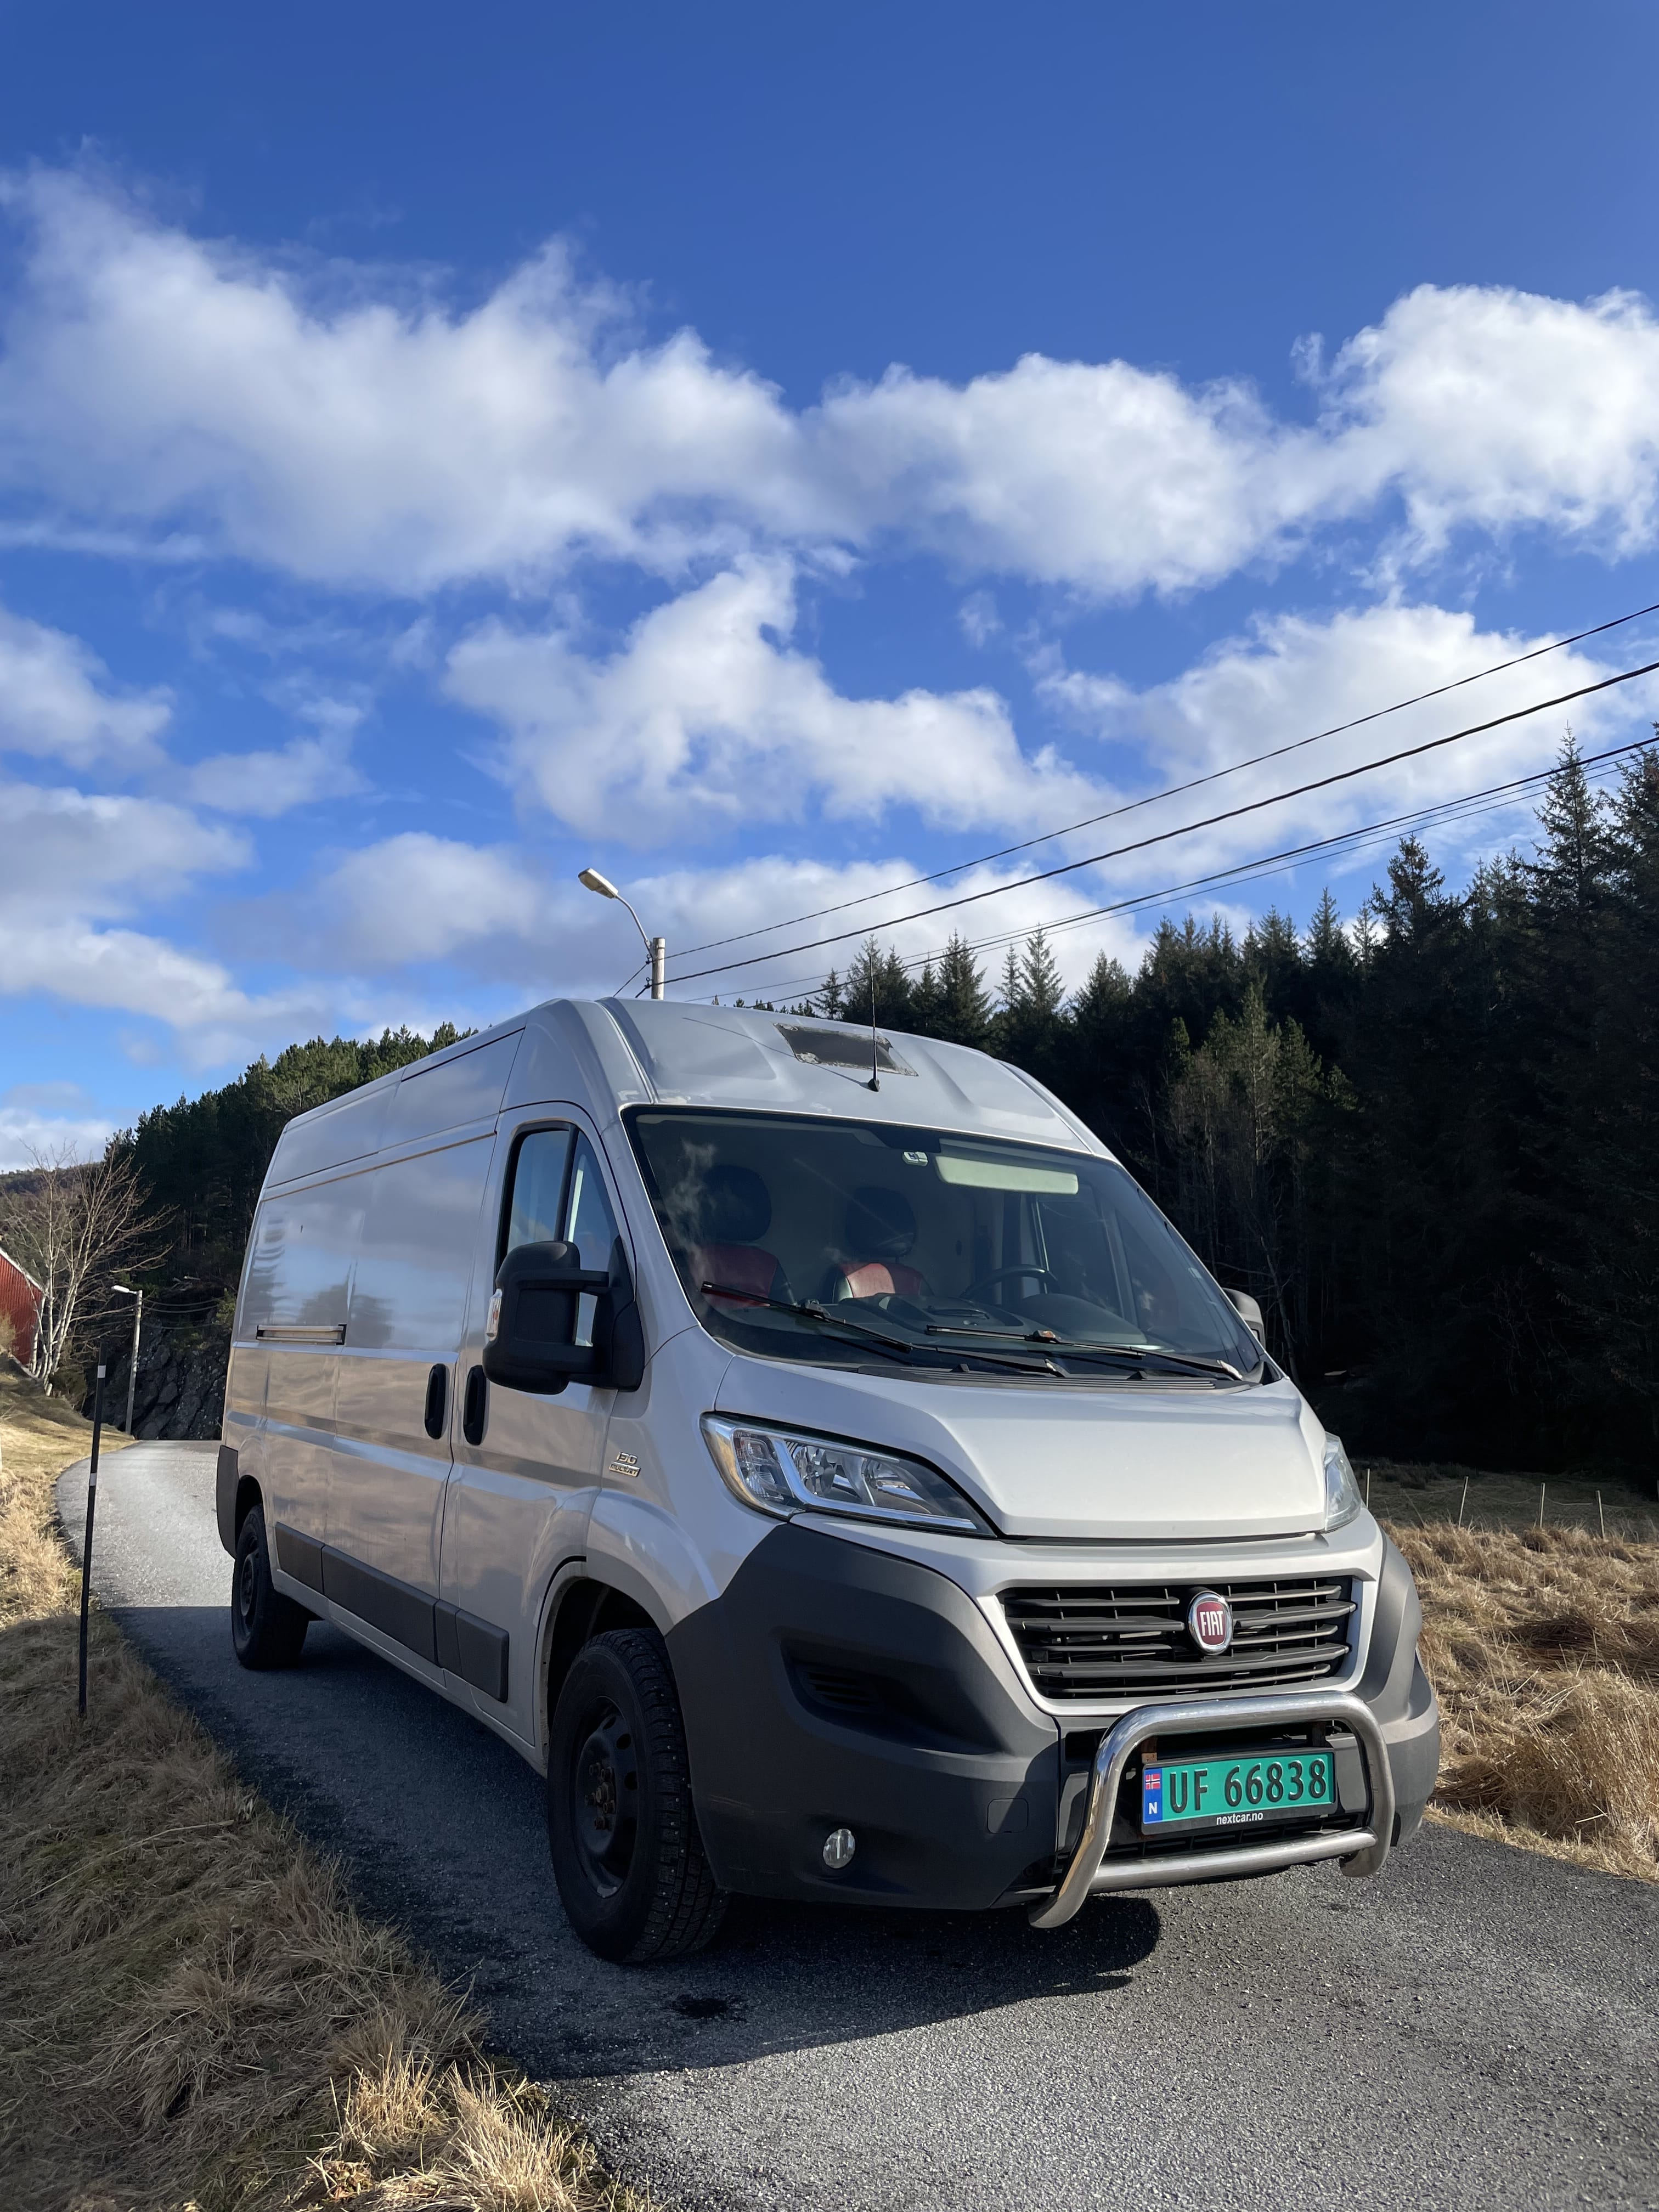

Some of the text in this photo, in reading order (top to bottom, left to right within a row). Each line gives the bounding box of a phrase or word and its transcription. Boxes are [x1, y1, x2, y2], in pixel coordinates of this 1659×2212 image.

[1200, 1611, 1223, 1636] FIAT
[1170, 1758, 1327, 1813] UF 66838
[1149, 1802, 1158, 1815] N
[1216, 1812, 1263, 1826] nextcar.no
